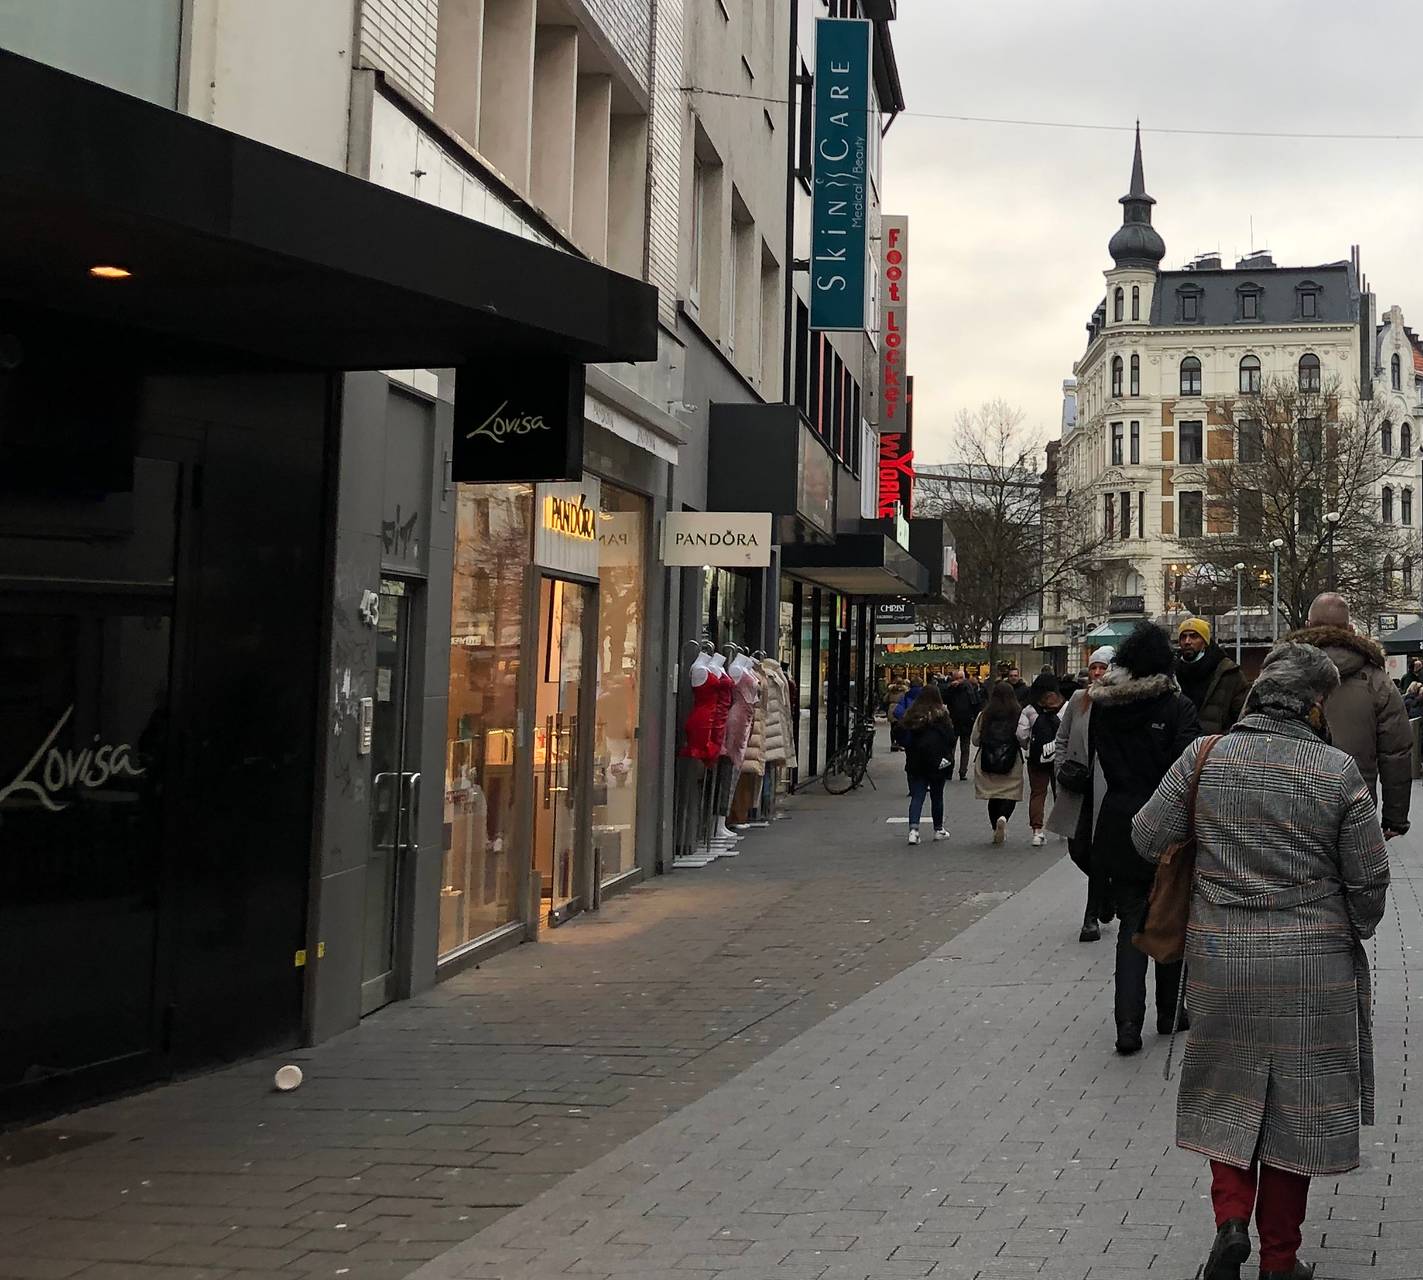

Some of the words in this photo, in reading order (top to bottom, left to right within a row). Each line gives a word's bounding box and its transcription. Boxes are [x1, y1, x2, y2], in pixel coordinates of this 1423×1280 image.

[853, 136, 865, 174] Beauty
[852, 182, 864, 228] Medical
[886, 228, 903, 302] Foot
[884, 311, 902, 418] Locker
[466, 400, 551, 443] Lovisa
[0, 703, 147, 811] Lovisa
